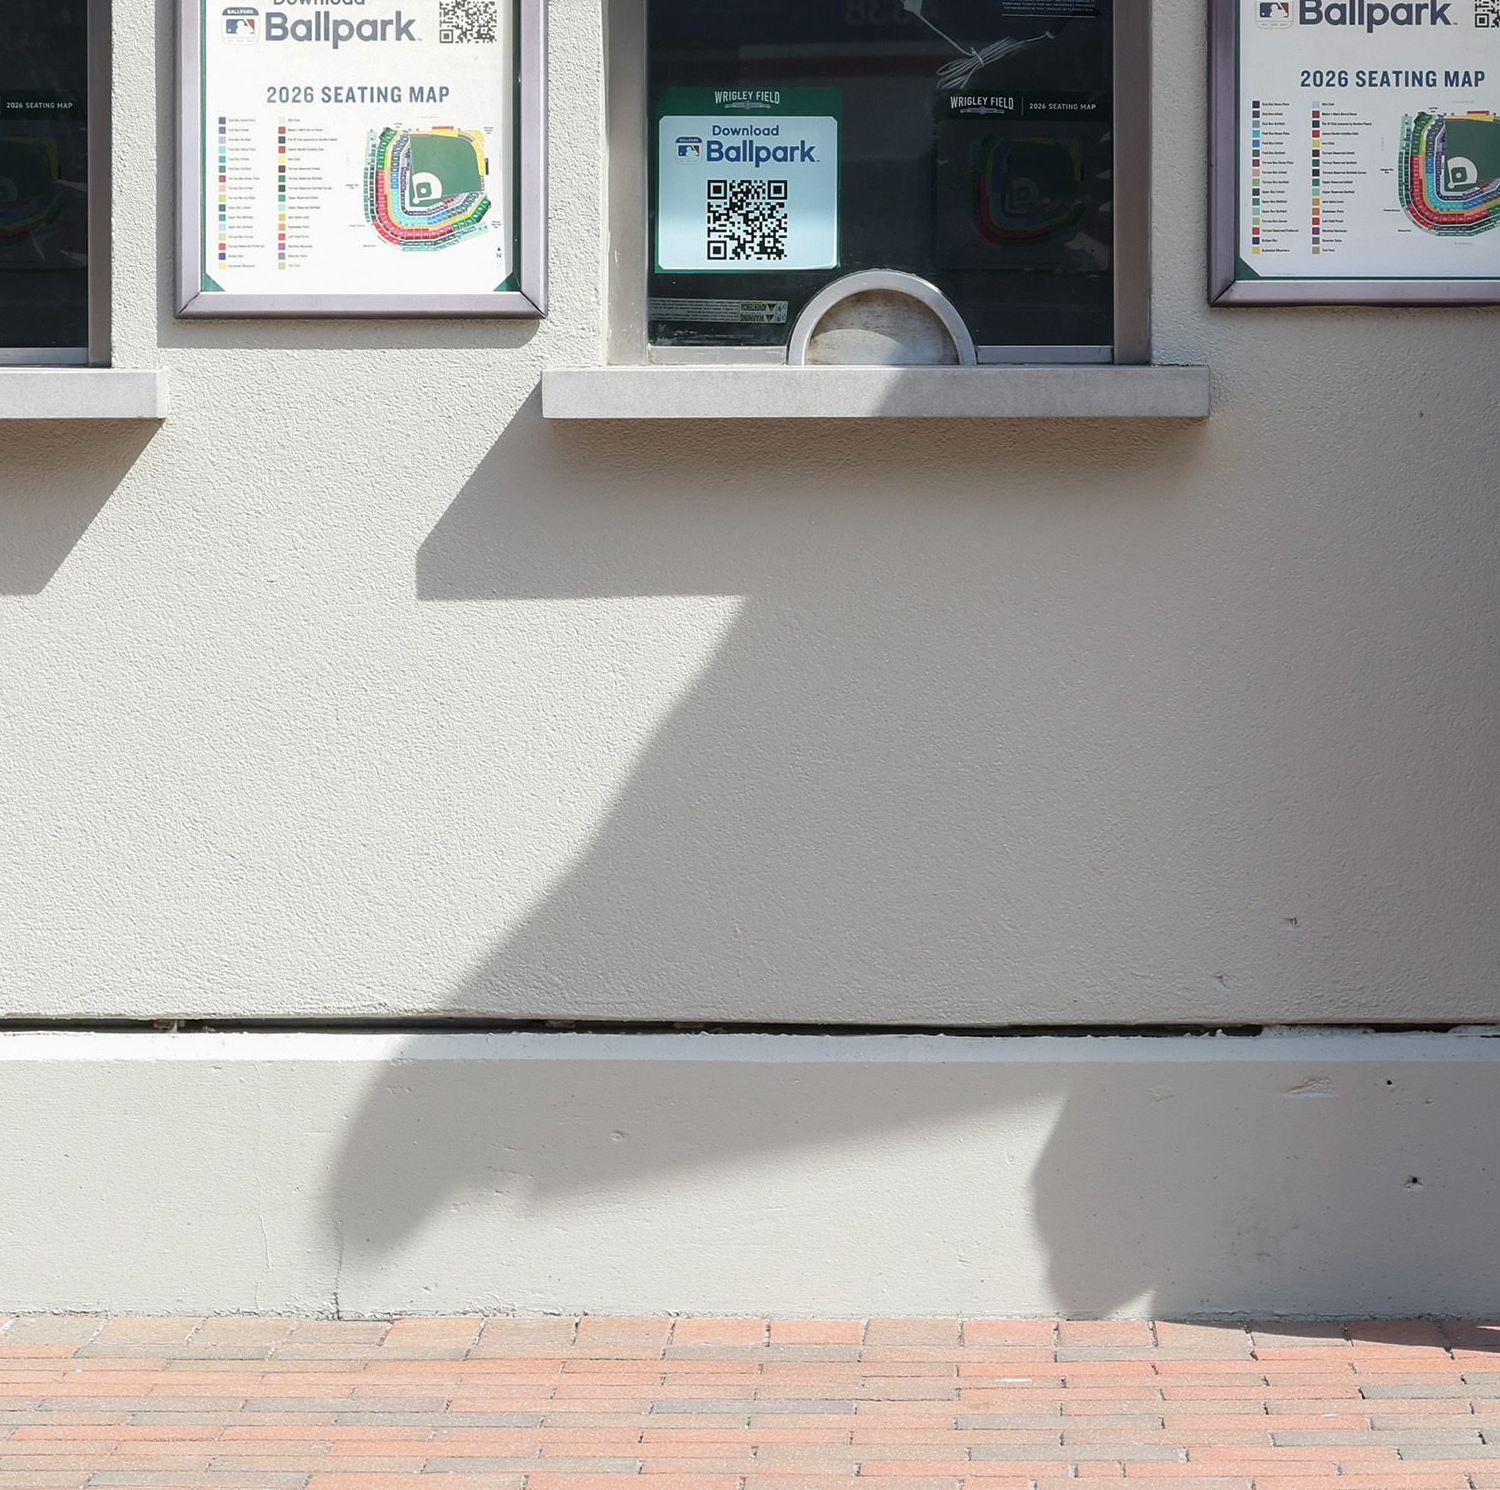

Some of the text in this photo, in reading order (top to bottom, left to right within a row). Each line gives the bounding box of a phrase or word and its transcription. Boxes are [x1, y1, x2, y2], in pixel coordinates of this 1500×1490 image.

[266, 11, 416, 49] Ballpark
[1301, 70, 1484, 87] 2026 SEATING MAP
[267, 86, 449, 103] 2026 SEATING MAP
[714, 91, 780, 104] WRIGLEY FIELD
[950, 96, 989, 110] WRIGLEY
[990, 96, 1013, 110] FIELD
[713, 125, 779, 136] Download
[707, 140, 815, 167] Ballpark
[740, 313, 765, 322] WARNING
